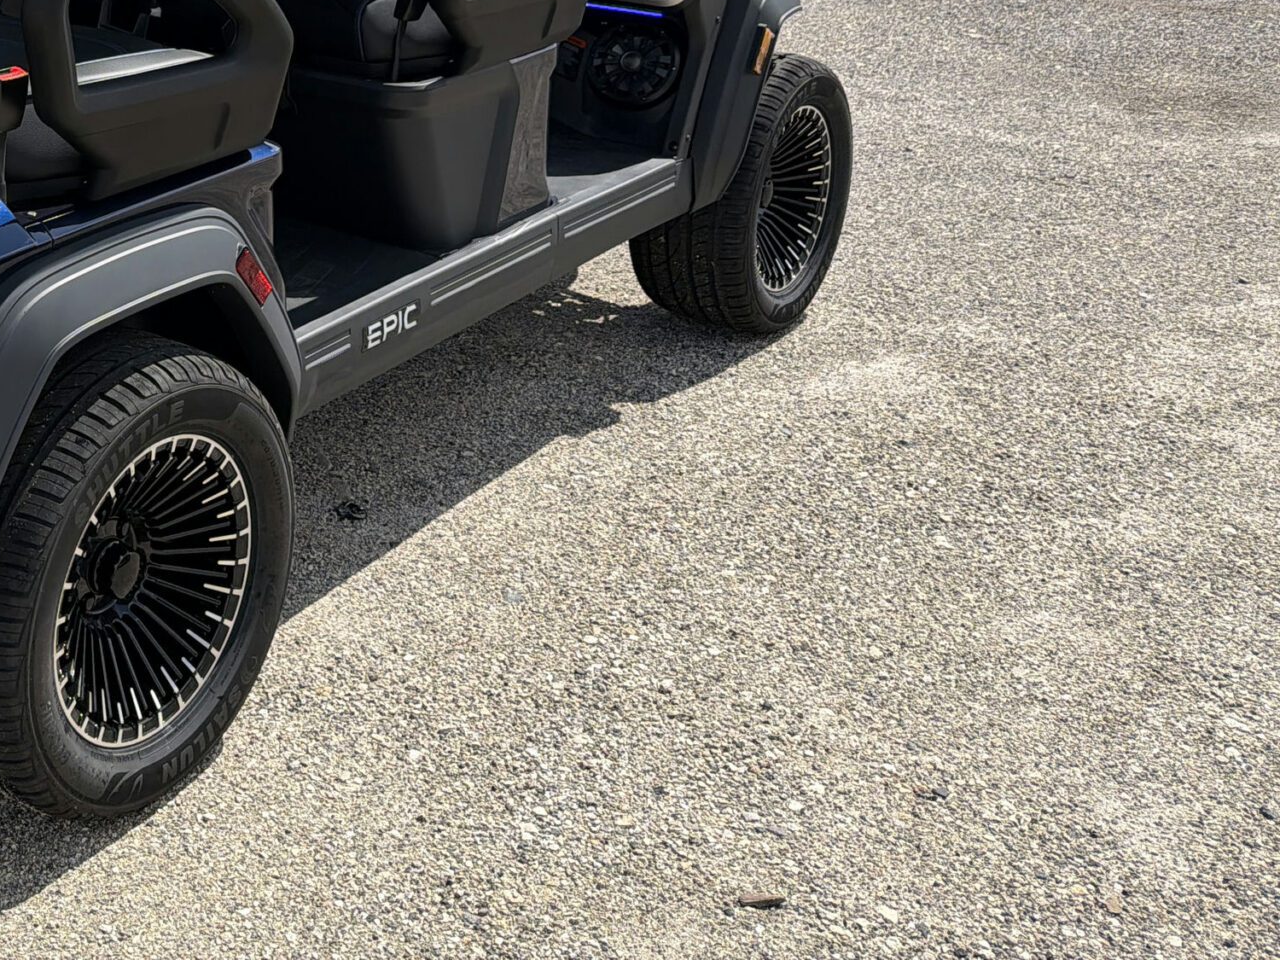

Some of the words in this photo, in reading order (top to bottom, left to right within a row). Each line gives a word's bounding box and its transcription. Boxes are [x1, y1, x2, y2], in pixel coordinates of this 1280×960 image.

[367, 304, 417, 349] EPIC
[75, 399, 185, 526] SHUTTLE
[161, 683, 242, 784] SAILUN
